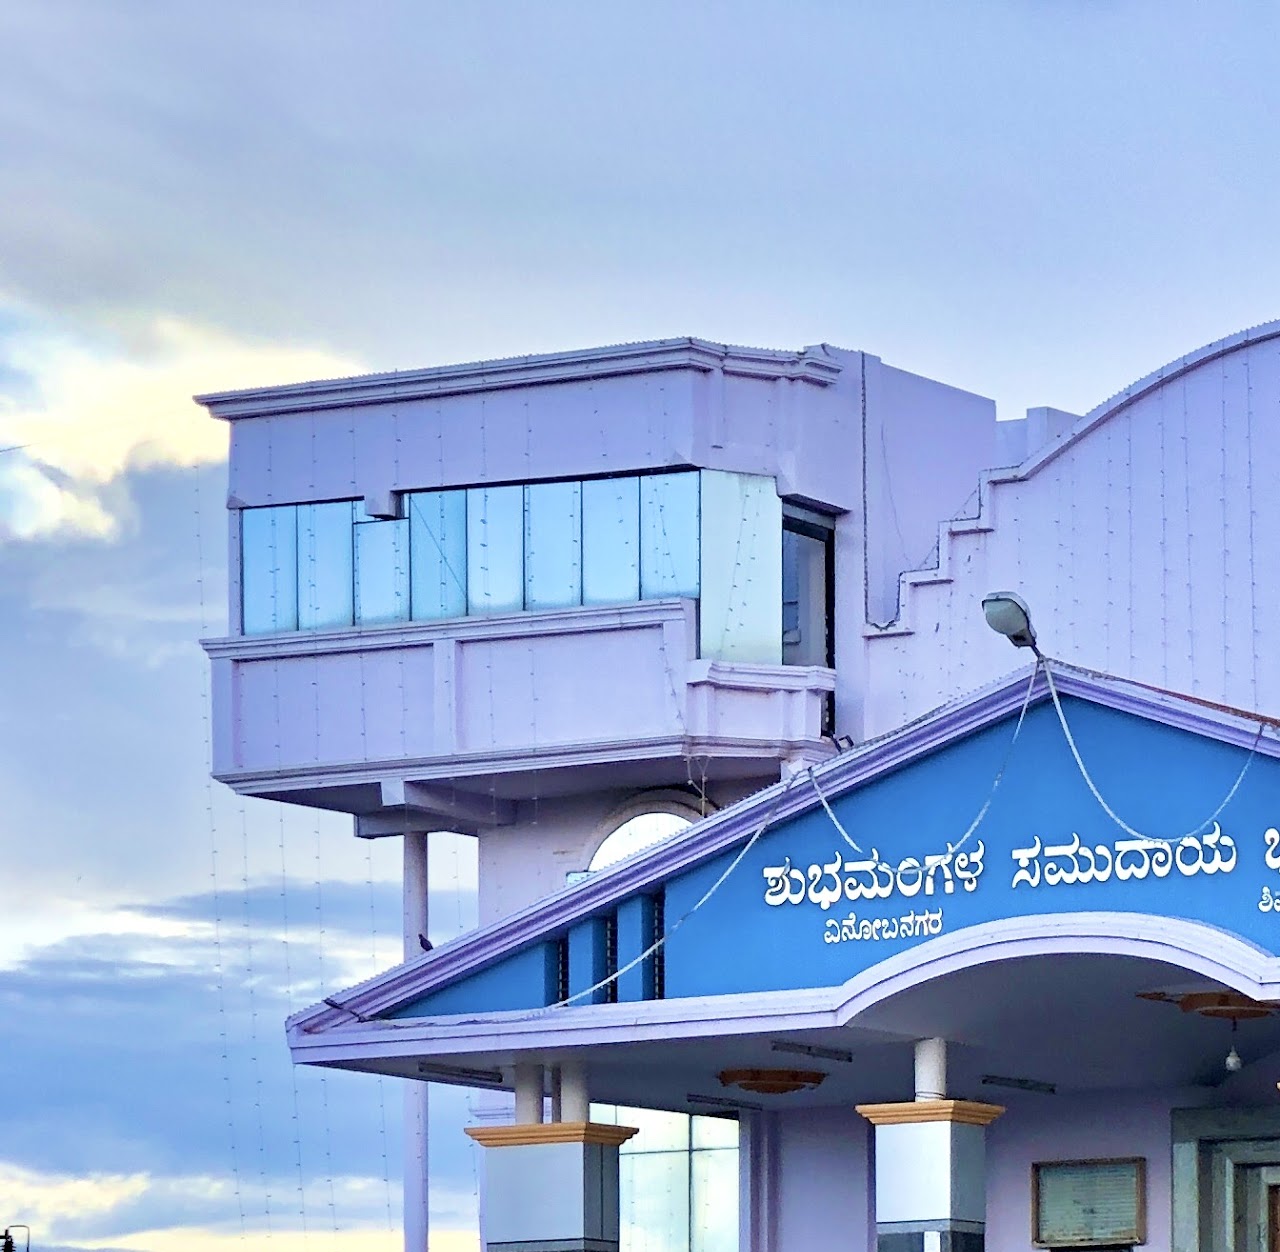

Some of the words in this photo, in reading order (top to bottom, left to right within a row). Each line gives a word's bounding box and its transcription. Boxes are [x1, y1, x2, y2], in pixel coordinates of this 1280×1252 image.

[762, 839, 985, 911] ಶುಭಮಂಗಳ
[1011, 821, 1237, 888] ಸಮುದಾಯ
[824, 908, 944, 944] ವಿನೋಬನಗರ
